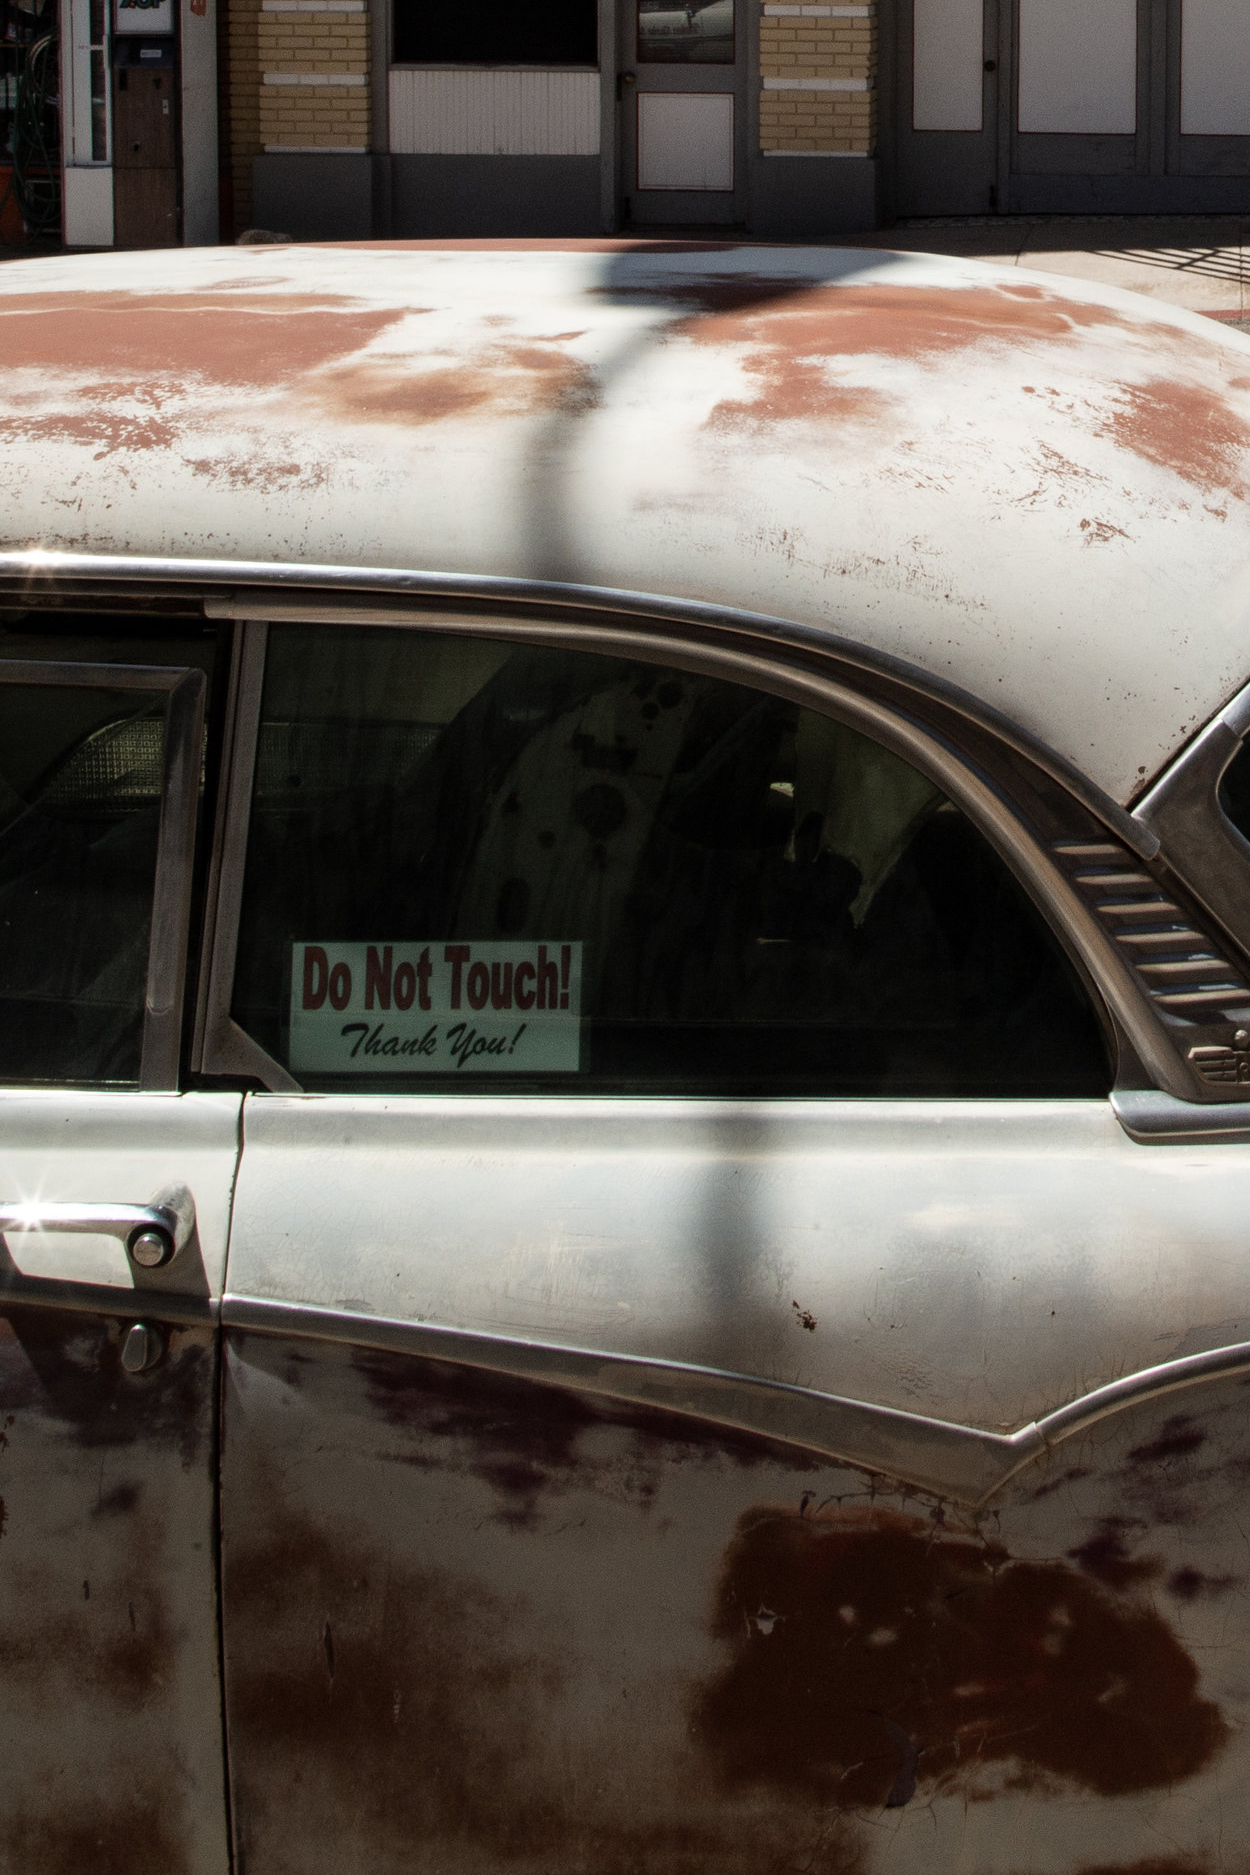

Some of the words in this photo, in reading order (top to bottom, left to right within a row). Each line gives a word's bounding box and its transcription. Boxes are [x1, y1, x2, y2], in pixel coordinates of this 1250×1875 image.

[302, 945, 352, 1011] Do
[364, 945, 432, 1011] Not
[444, 944, 571, 1011] Touch!
[340, 1022, 438, 1058] Thank
[446, 1022, 527, 1069] You!
